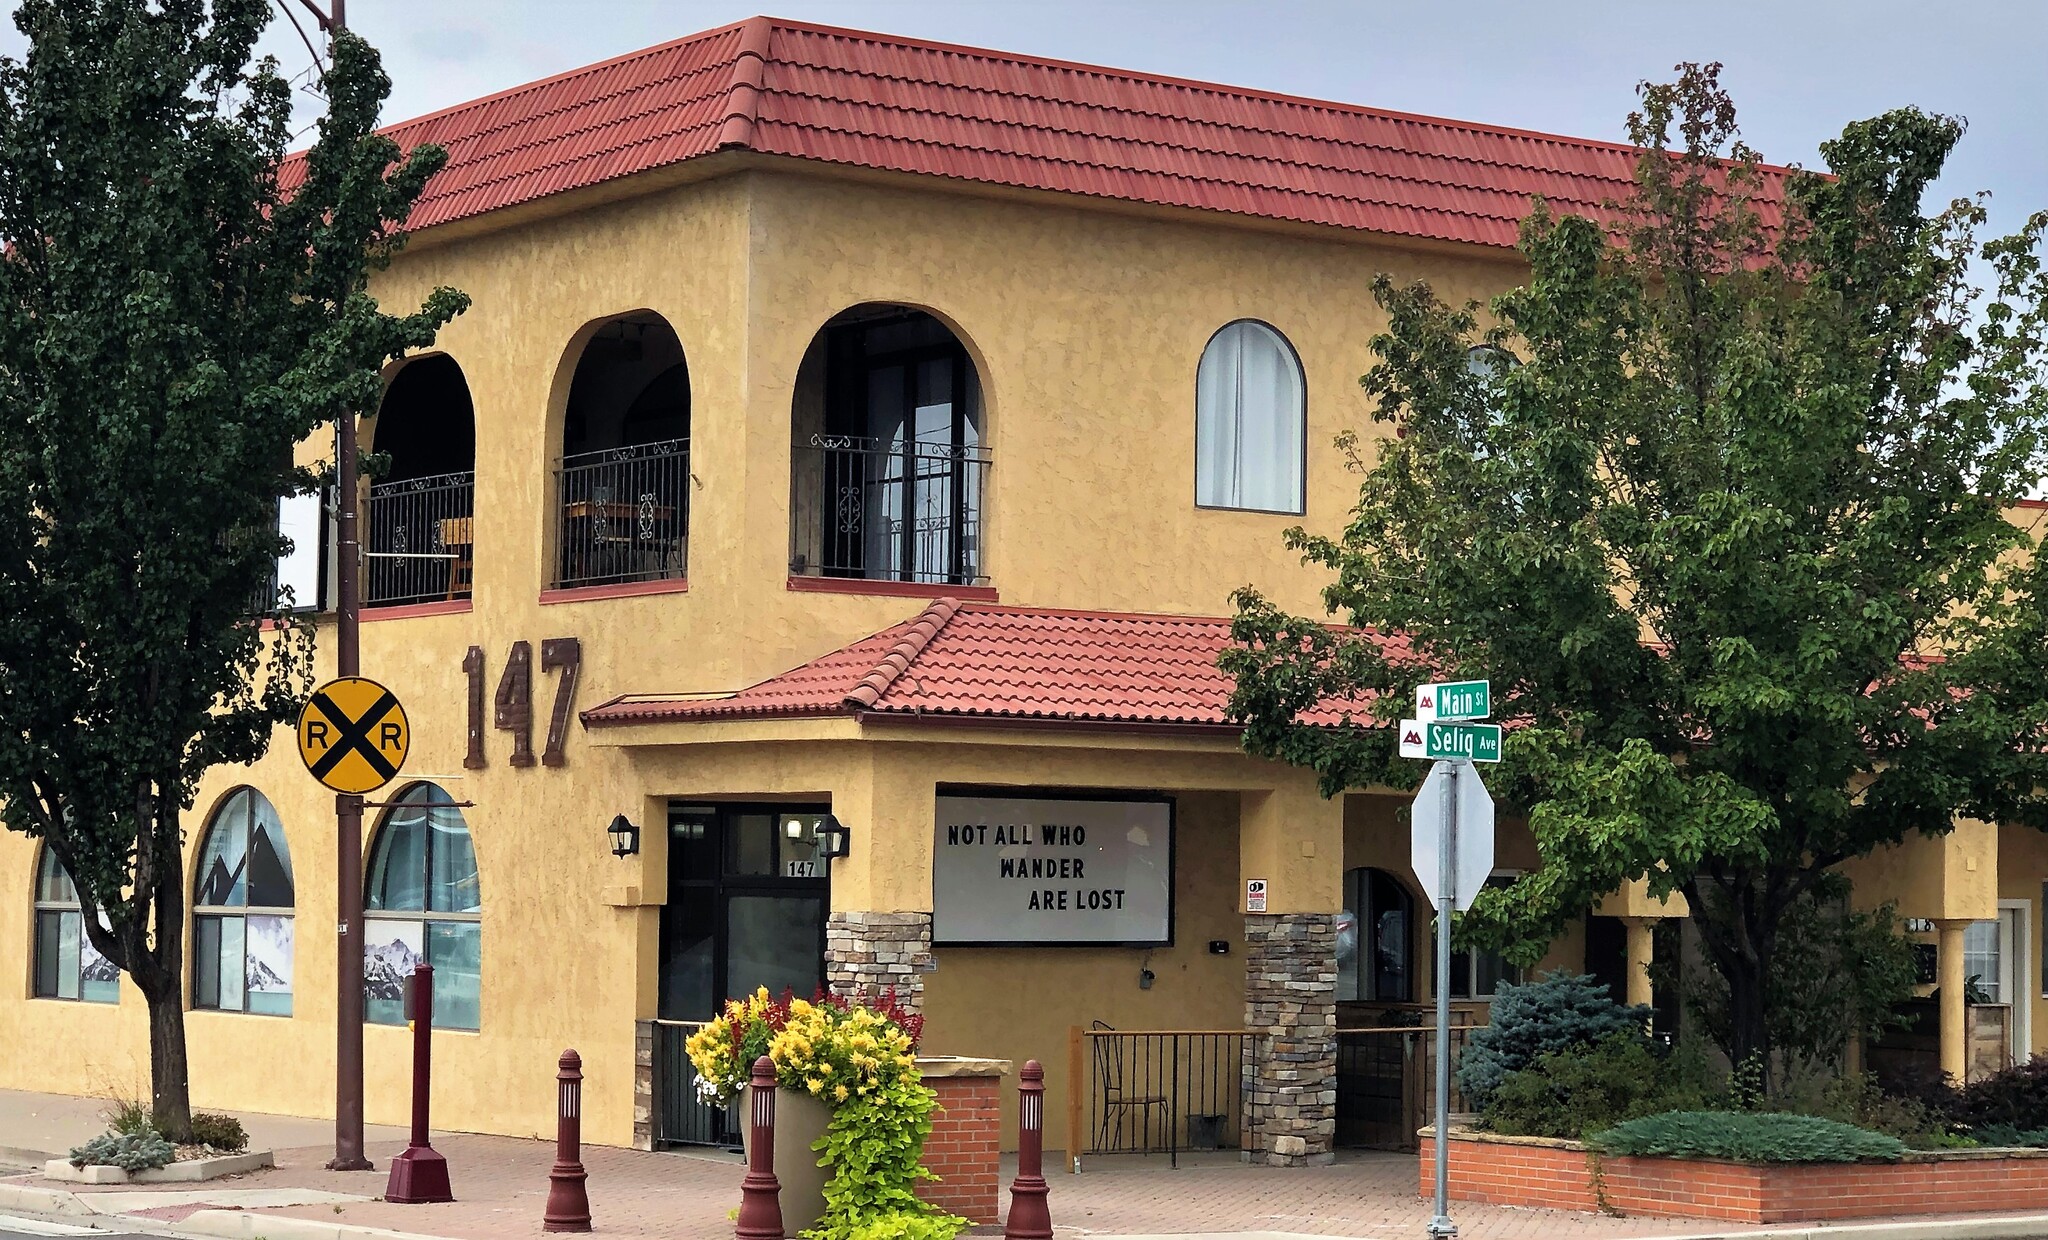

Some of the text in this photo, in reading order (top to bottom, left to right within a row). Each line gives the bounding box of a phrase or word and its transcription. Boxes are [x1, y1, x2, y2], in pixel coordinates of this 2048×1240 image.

[462, 637, 580, 769] 147
[1441, 688, 1484, 715] Main St
[307, 721, 401, 750] R R
[1431, 725, 1496, 758] Selig Ave
[948, 825, 1086, 845] NOT ALL WHO
[789, 861, 815, 877] 147
[1000, 858, 1085, 879] WANDER
[1028, 889, 1125, 910] ARE LOST
